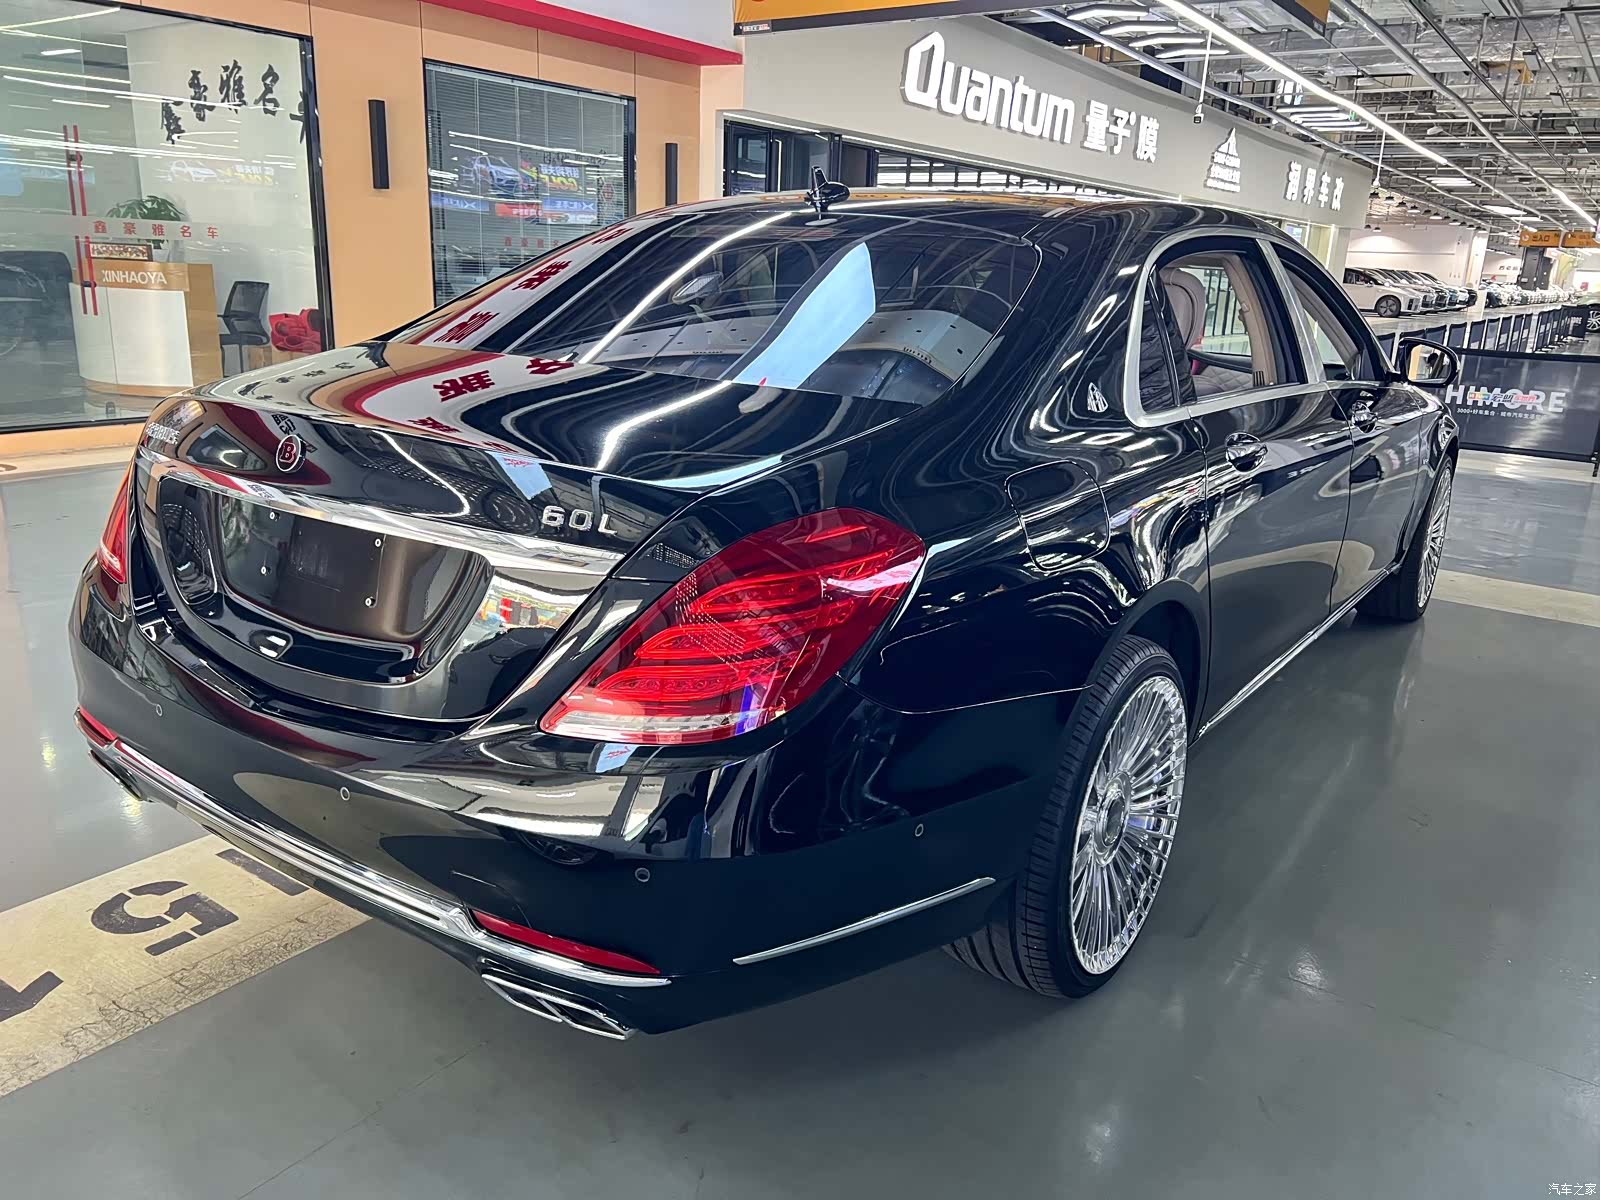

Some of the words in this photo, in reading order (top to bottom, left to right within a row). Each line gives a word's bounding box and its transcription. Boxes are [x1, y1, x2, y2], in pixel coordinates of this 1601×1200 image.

[904, 31, 1075, 144] Quantum
[93, 220, 219, 239] 鑫豪雅名车
[102, 270, 168, 285] XINHAOYA
[1445, 384, 1566, 412] HIMORE
[278, 441, 298, 464] B
